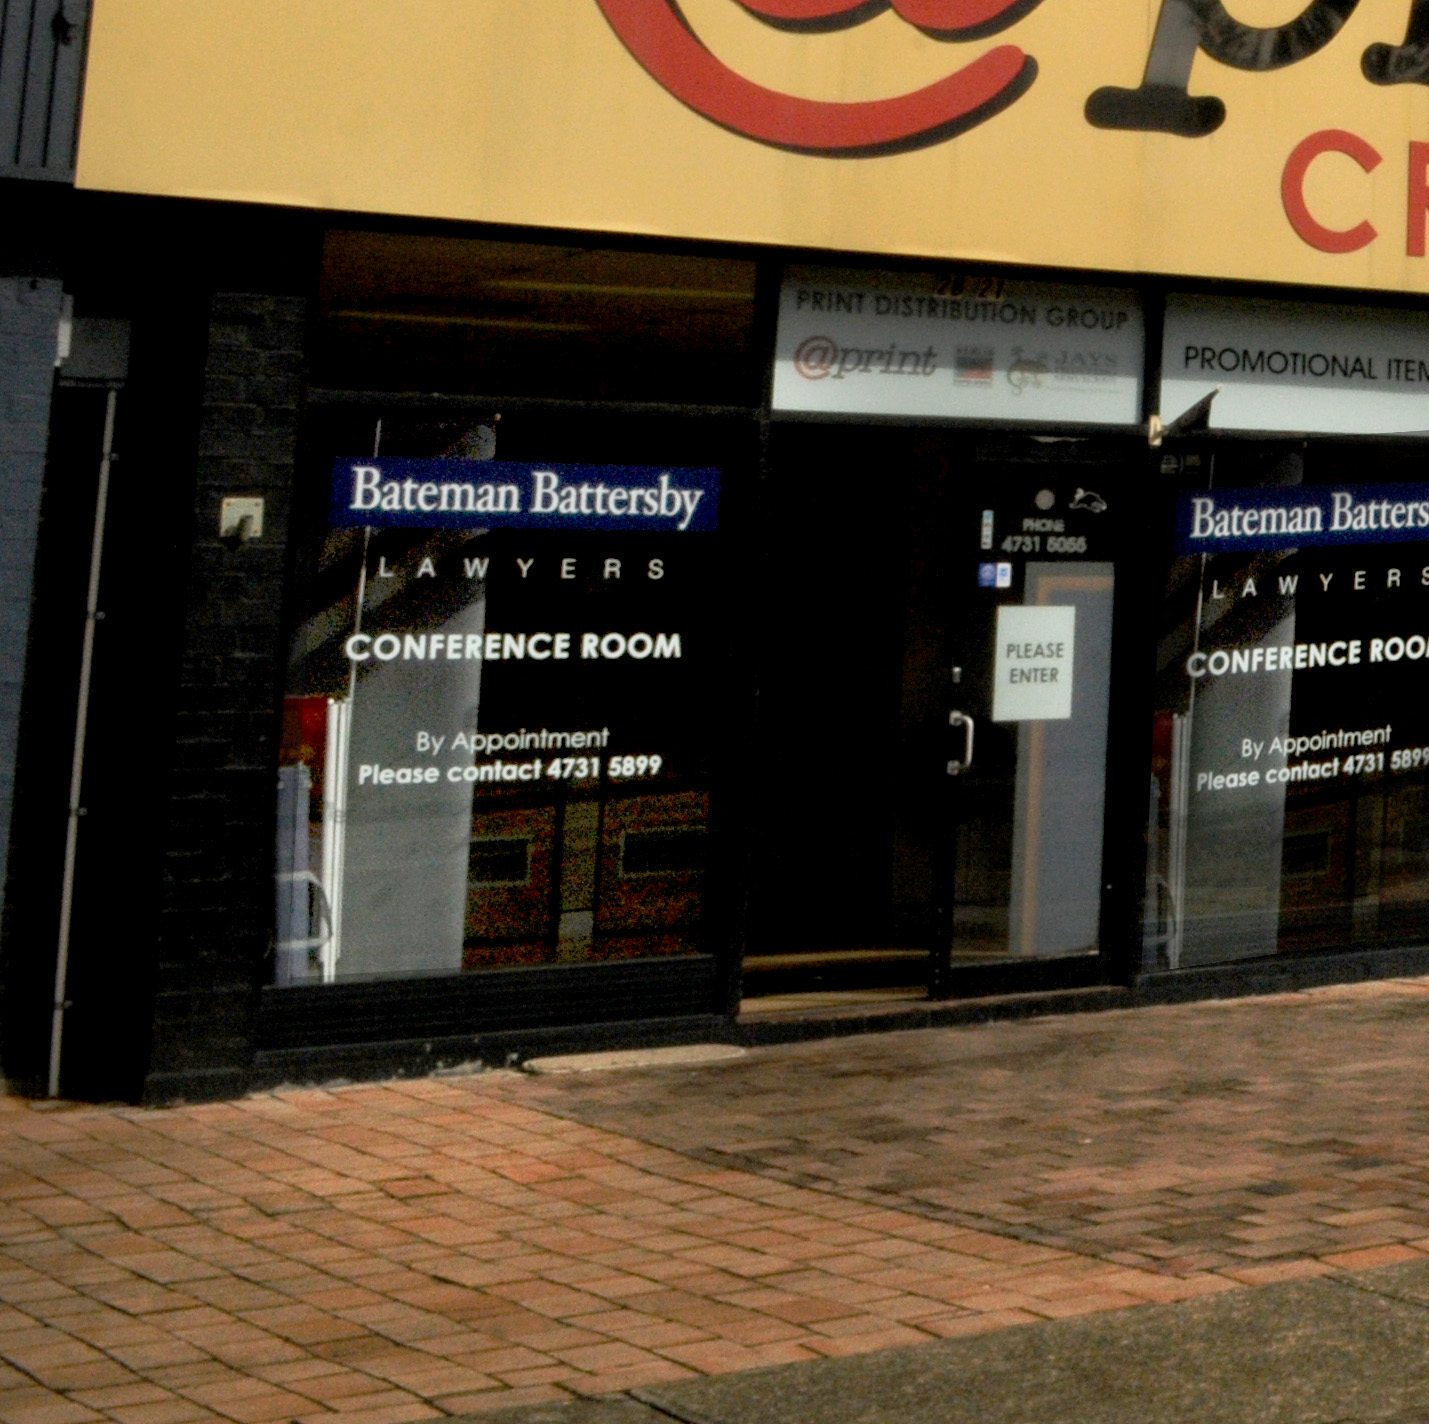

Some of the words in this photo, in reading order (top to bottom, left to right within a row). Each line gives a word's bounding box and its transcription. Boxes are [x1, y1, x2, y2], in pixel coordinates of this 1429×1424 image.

[796, 290, 863, 314] PRINT
[875, 293, 1037, 326] DISTRIBUTION
[1046, 306, 1128, 331] GROUP
[794, 336, 939, 380] @print
[1183, 345, 1377, 381] PROMOTIONAL
[350, 465, 520, 514] Bateman
[530, 472, 704, 529] Battersby
[1022, 517, 1065, 533] PHONE
[1191, 496, 1323, 540] Bateman
[1001, 535, 1041, 554] 4731
[345, 632, 571, 662] CONFERENCE
[580, 632, 682, 660] ROOM
[1006, 642, 1064, 660] PLEASE
[1186, 639, 1362, 679] CONFERENCE
[1009, 667, 1059, 684] ENTER
[416, 730, 445, 754] By
[452, 726, 610, 755] Appointment
[1242, 737, 1265, 759] By
[1269, 723, 1393, 756] Appointment
[358, 763, 440, 786] Please
[447, 759, 544, 784] contact
[547, 756, 601, 780] 4731
[608, 753, 663, 777] 5899
[1197, 769, 1260, 792] Please
[1265, 759, 1339, 785] contact
[1343, 752, 1387, 777] 4731
